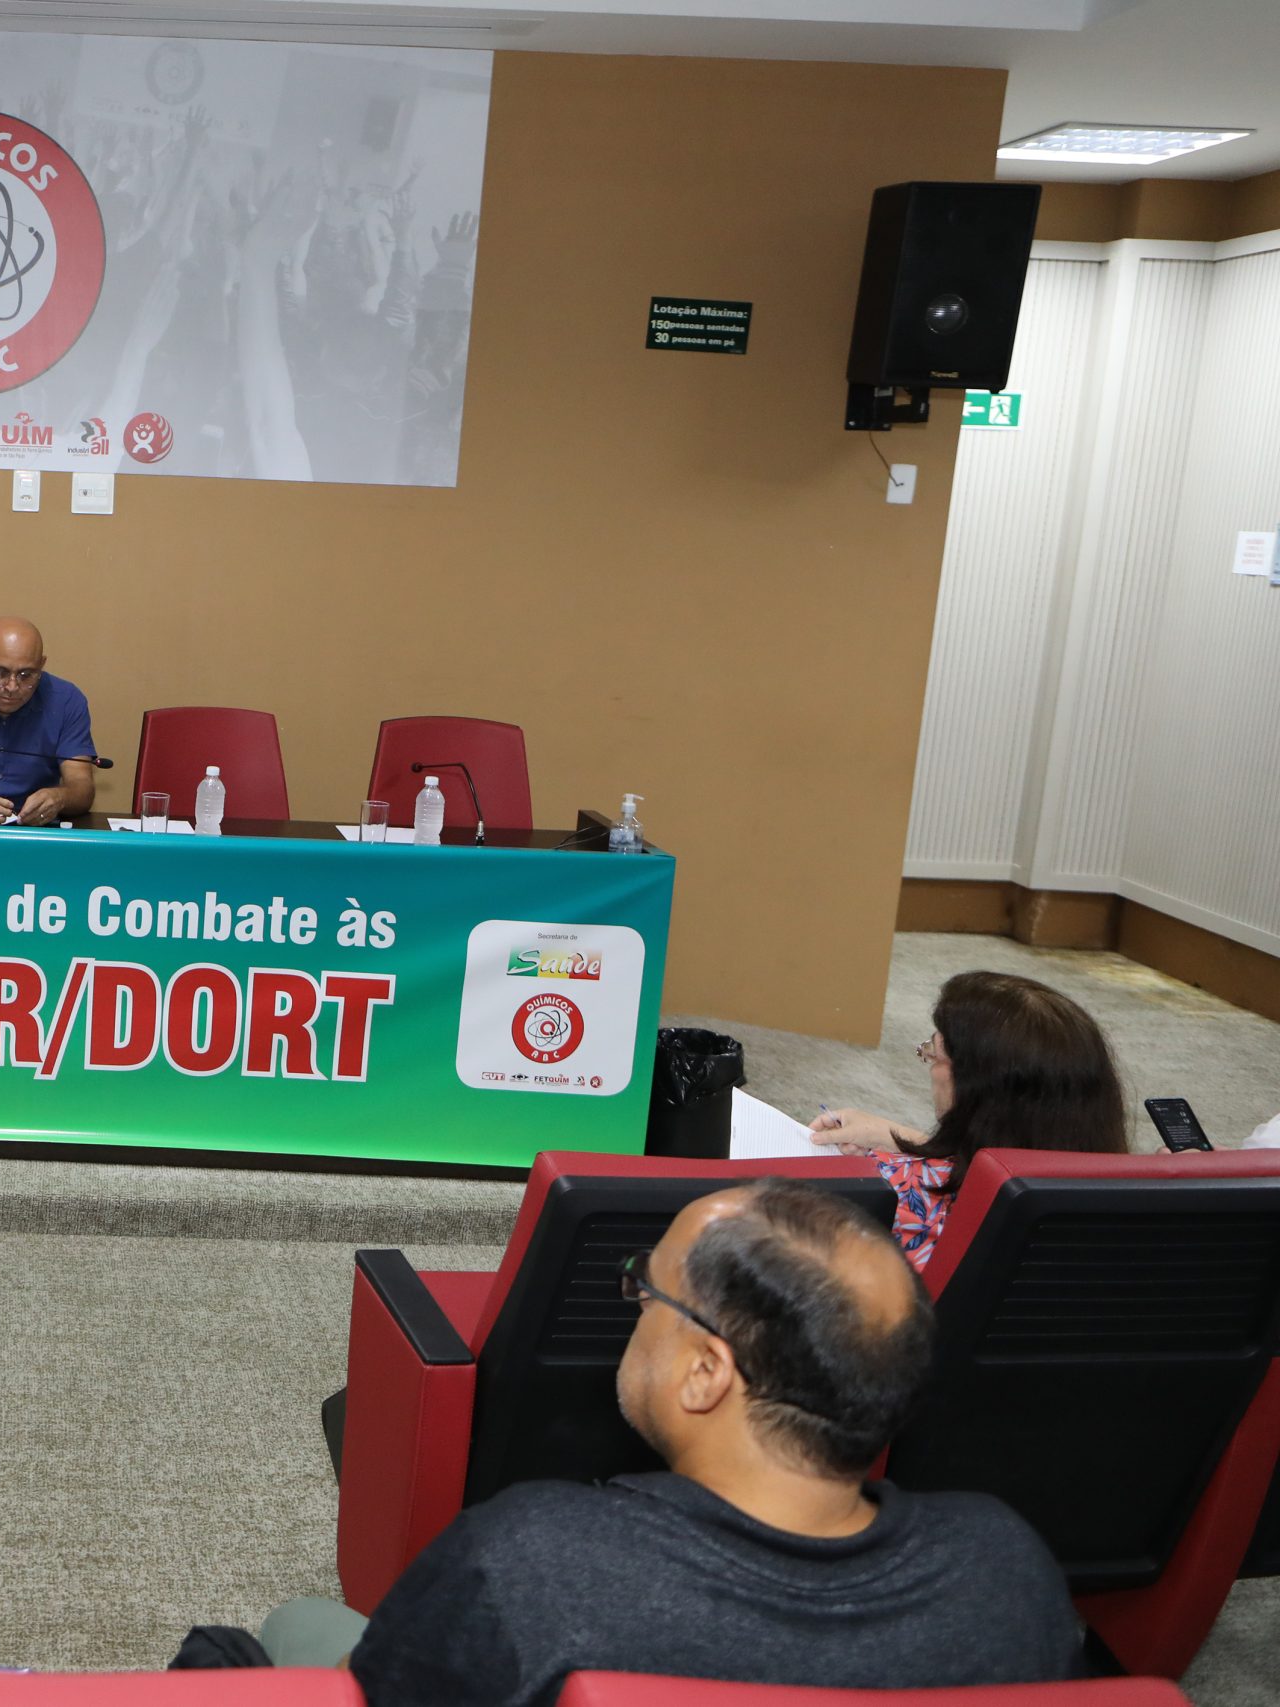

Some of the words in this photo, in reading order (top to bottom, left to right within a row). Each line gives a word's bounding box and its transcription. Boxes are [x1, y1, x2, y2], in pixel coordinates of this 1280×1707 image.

[653, 304, 698, 317] Lotação
[700, 307, 748, 319] Máxima:
[706, 324, 745, 333] sentadas
[654, 332, 669, 343] 30
[671, 335, 706, 345] pessoas
[723, 338, 735, 347] pé
[6, 883, 67, 935] de
[87, 885, 318, 945] Combate
[336, 897, 397, 949] às
[526, 996, 573, 1014] QUÍMICOS
